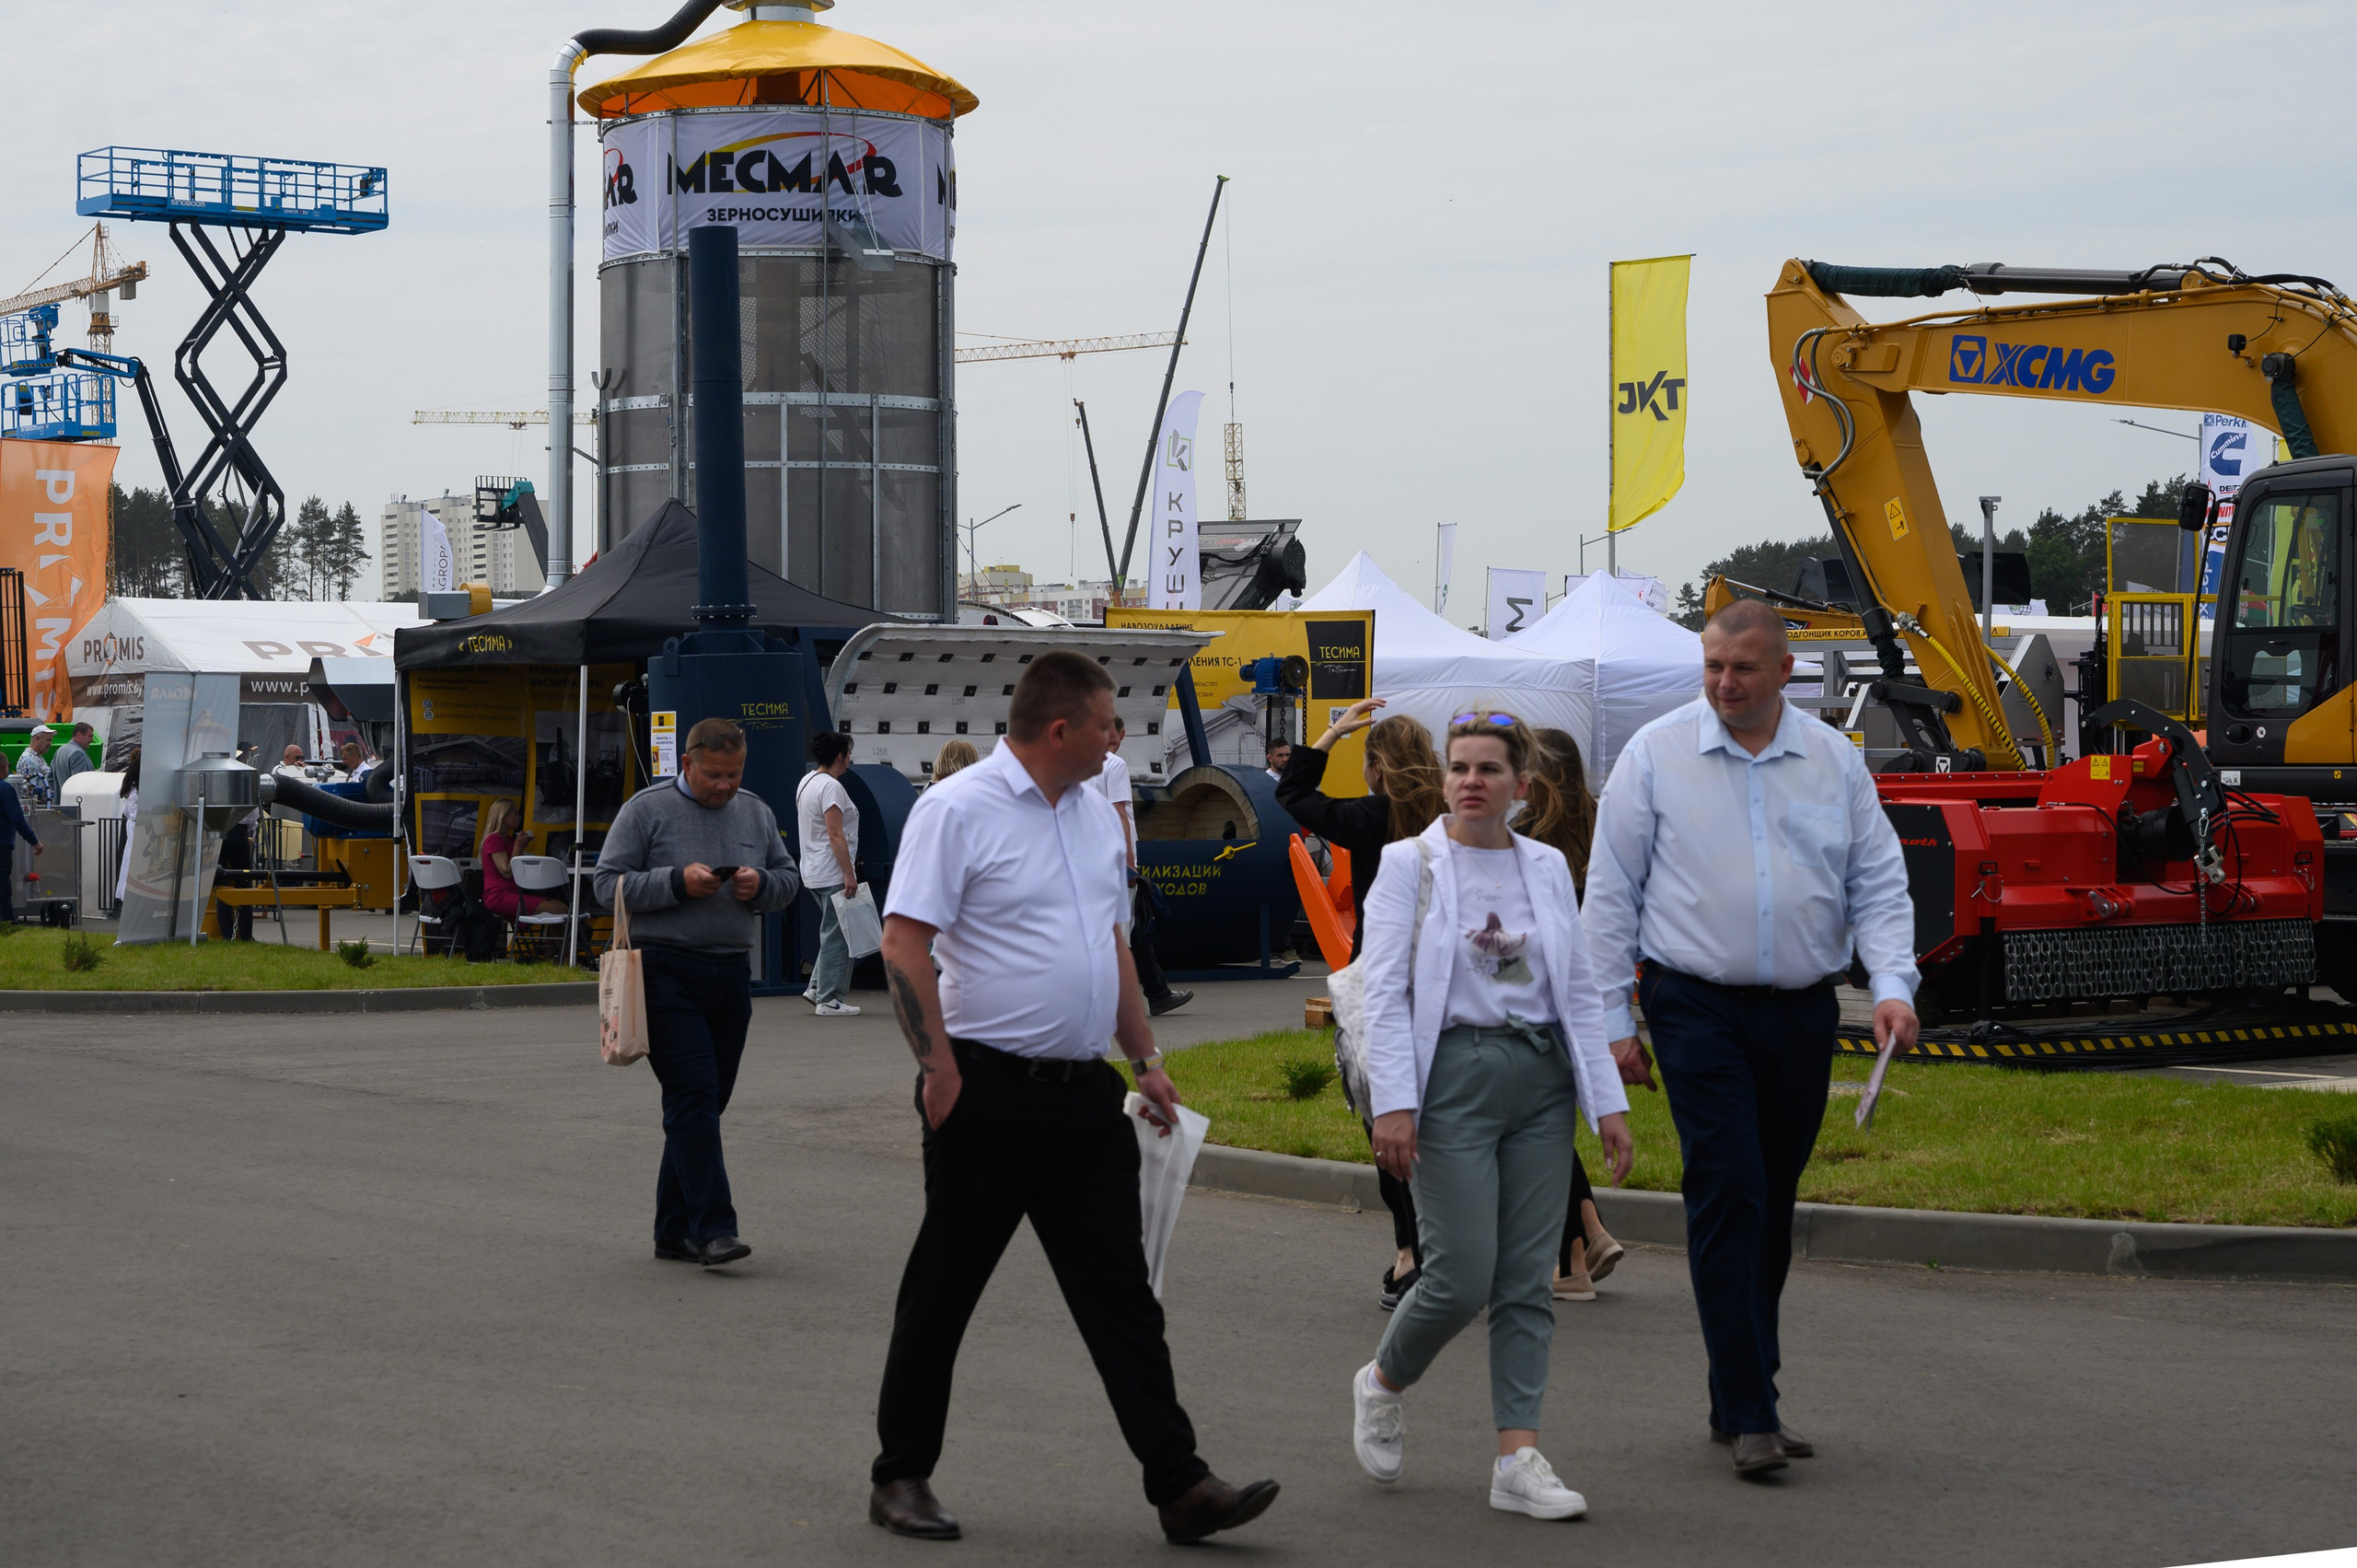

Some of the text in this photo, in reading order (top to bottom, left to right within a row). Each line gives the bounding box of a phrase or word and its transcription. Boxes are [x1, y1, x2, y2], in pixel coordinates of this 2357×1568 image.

[668, 149, 903, 197] MECMAR
[706, 207, 860, 222] ЗЕРНОСУШИЛКИ
[1982, 343, 2116, 394] XCMG
[1618, 370, 1685, 421] JKT
[2211, 433, 2245, 459] Cummins
[1834, 629, 1861, 637] КОРОВ
[84, 632, 144, 667] PROMIS
[1318, 645, 1360, 658] ТЕСИМА
[479, 665, 510, 674] КОРОВ
[87, 679, 144, 698] www.promis.by
[740, 703, 789, 716] ТЕСИМА
